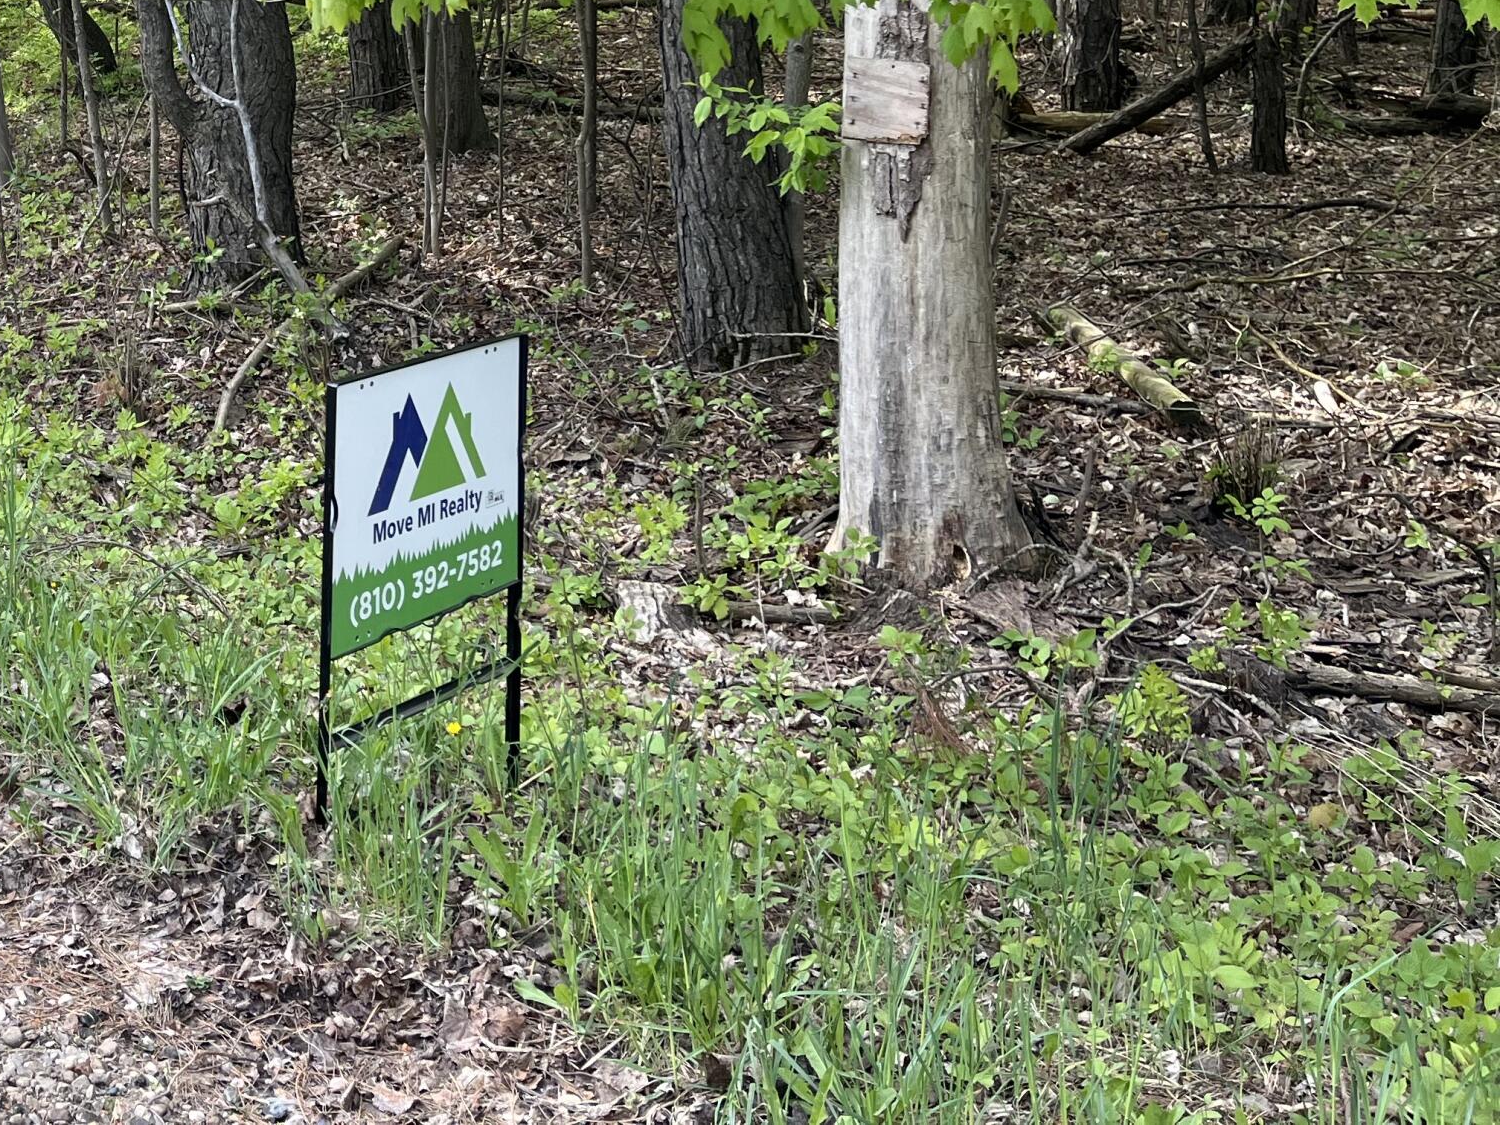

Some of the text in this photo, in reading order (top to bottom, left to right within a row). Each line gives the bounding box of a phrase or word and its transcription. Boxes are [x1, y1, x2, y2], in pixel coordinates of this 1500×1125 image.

[373, 516, 413, 544] Move
[418, 503, 435, 528] MI
[440, 489, 483, 520] Realty
[350, 540, 503, 628] (810) 392-7582
